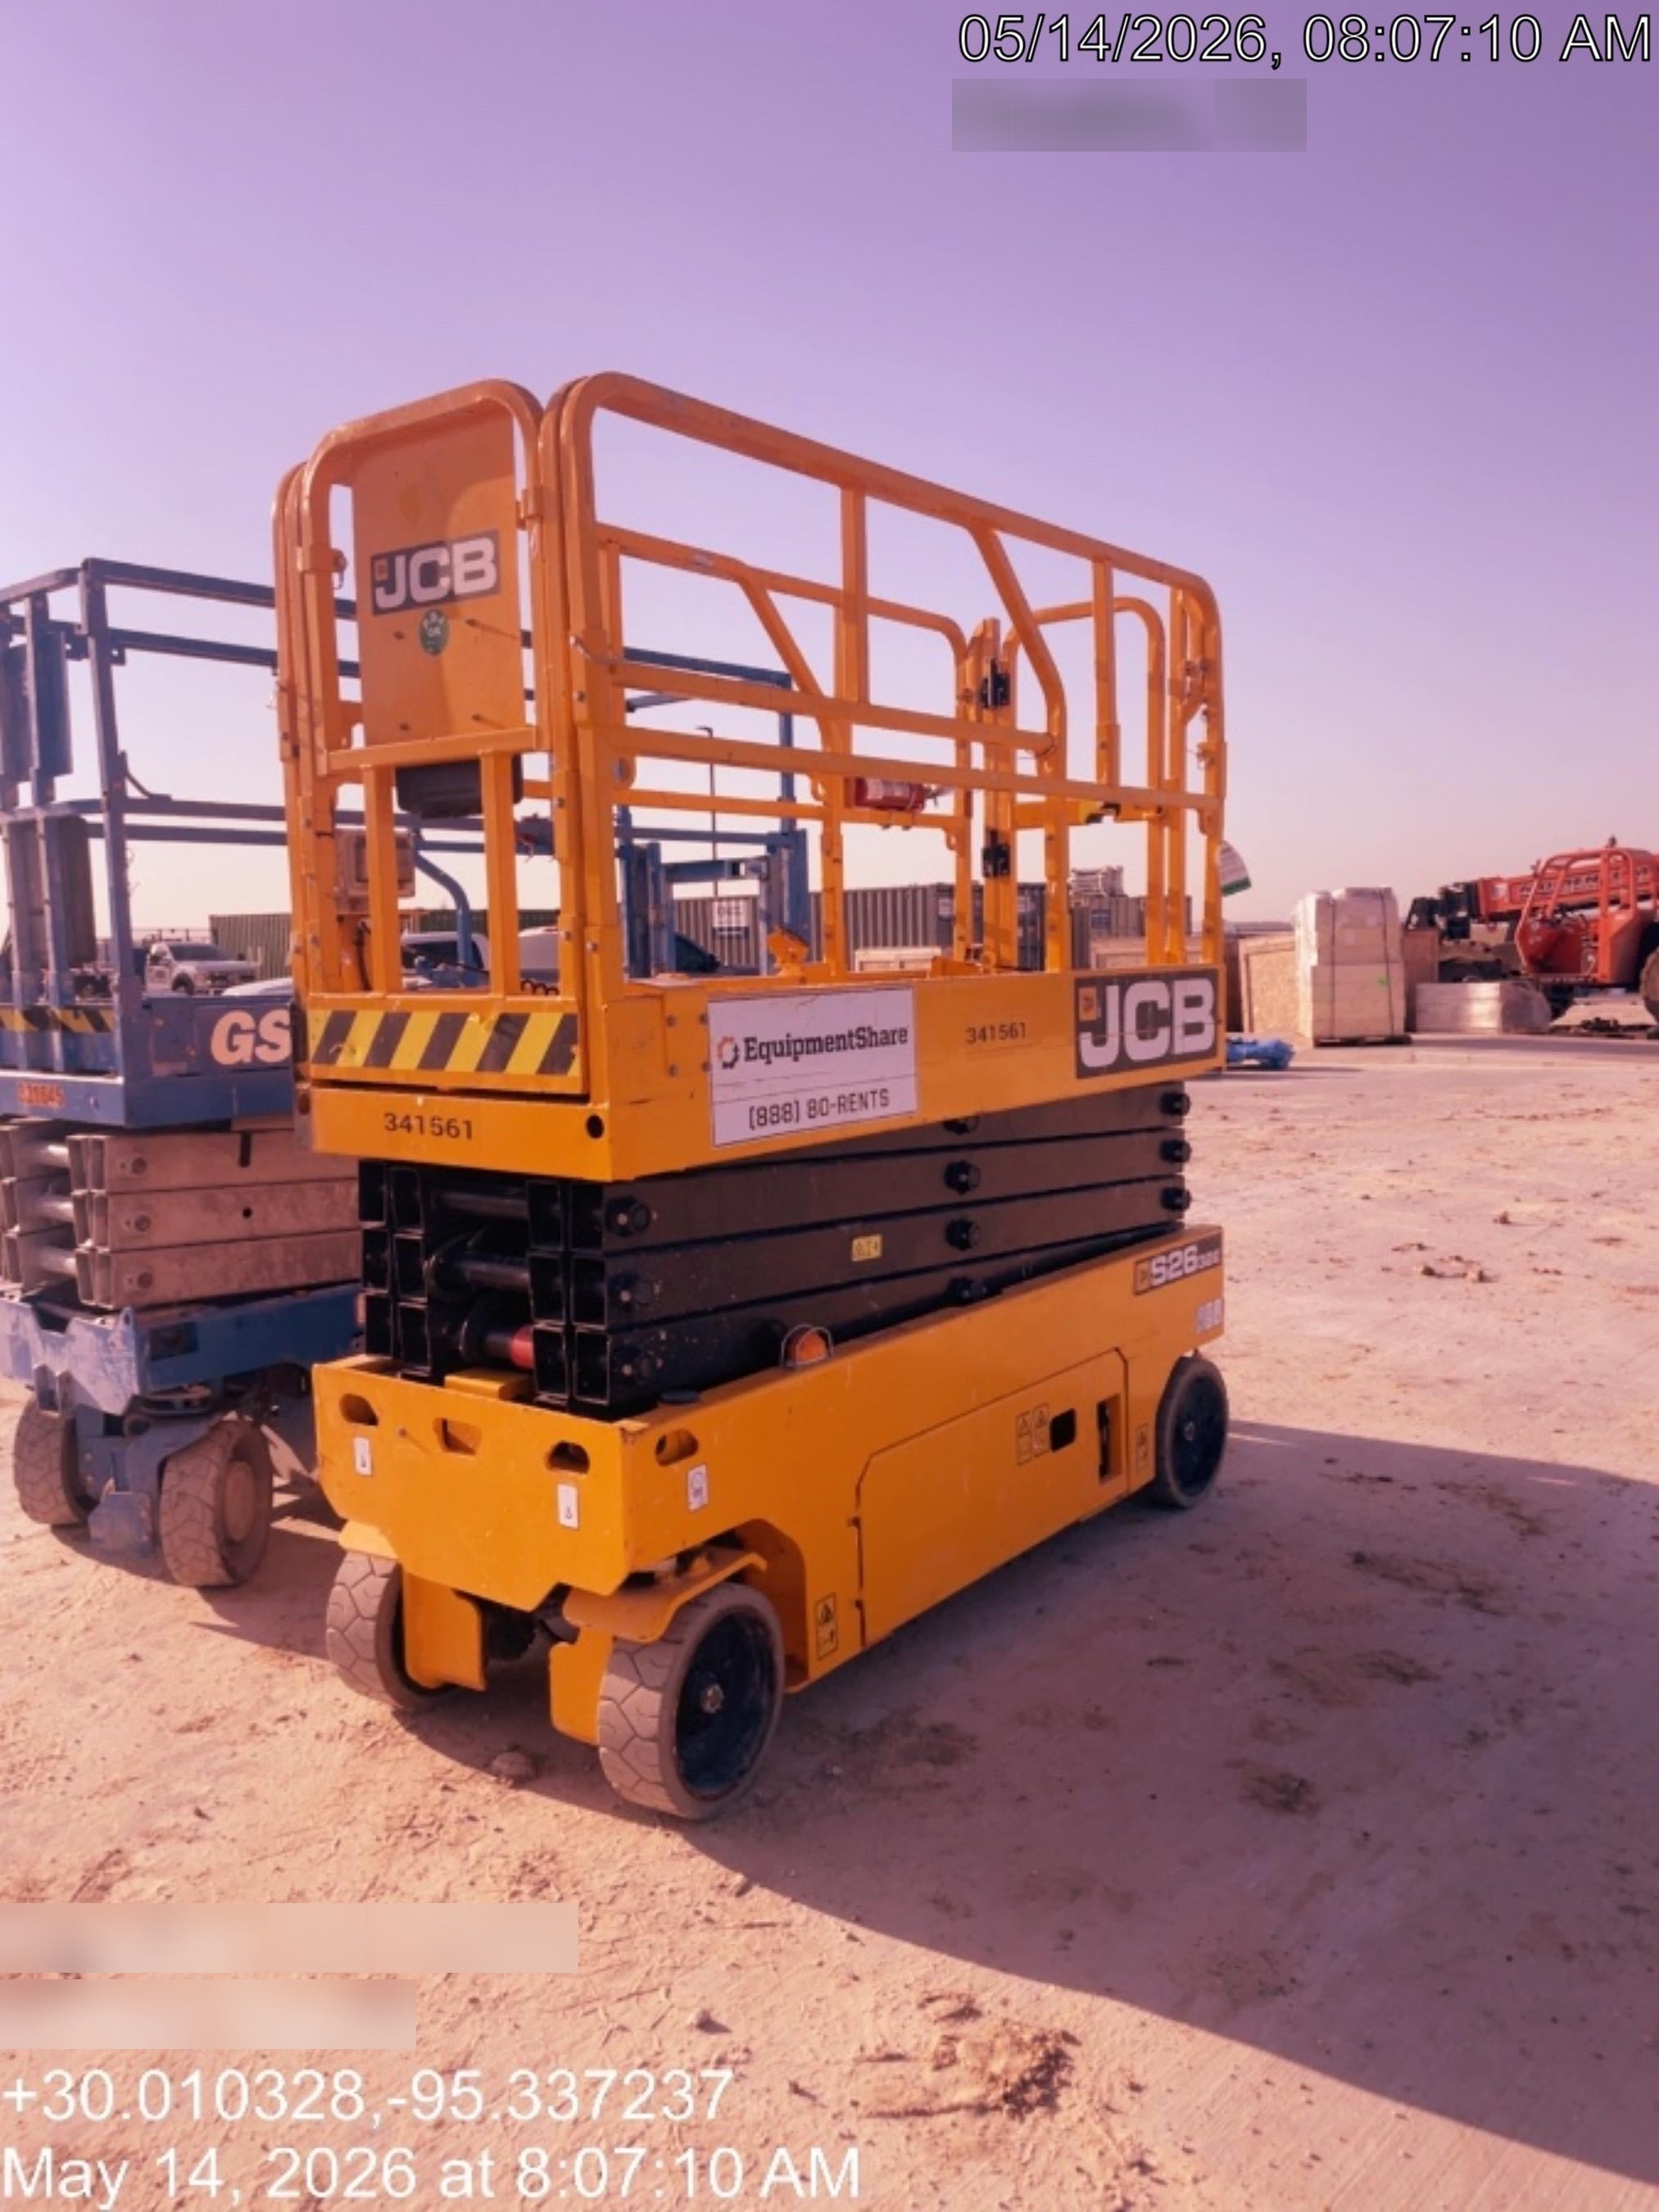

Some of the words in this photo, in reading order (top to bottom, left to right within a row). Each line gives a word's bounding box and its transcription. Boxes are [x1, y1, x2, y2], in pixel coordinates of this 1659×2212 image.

[374, 537, 497, 609] JCB
[966, 1022, 1027, 1045] 341561
[1078, 977, 1215, 1068] JCB
[743, 1027, 909, 1065] EquipmentShare
[383, 1112, 473, 1140] 341561
[748, 1099, 800, 1131] (888)
[806, 1088, 891, 1120] 80-RENTS
